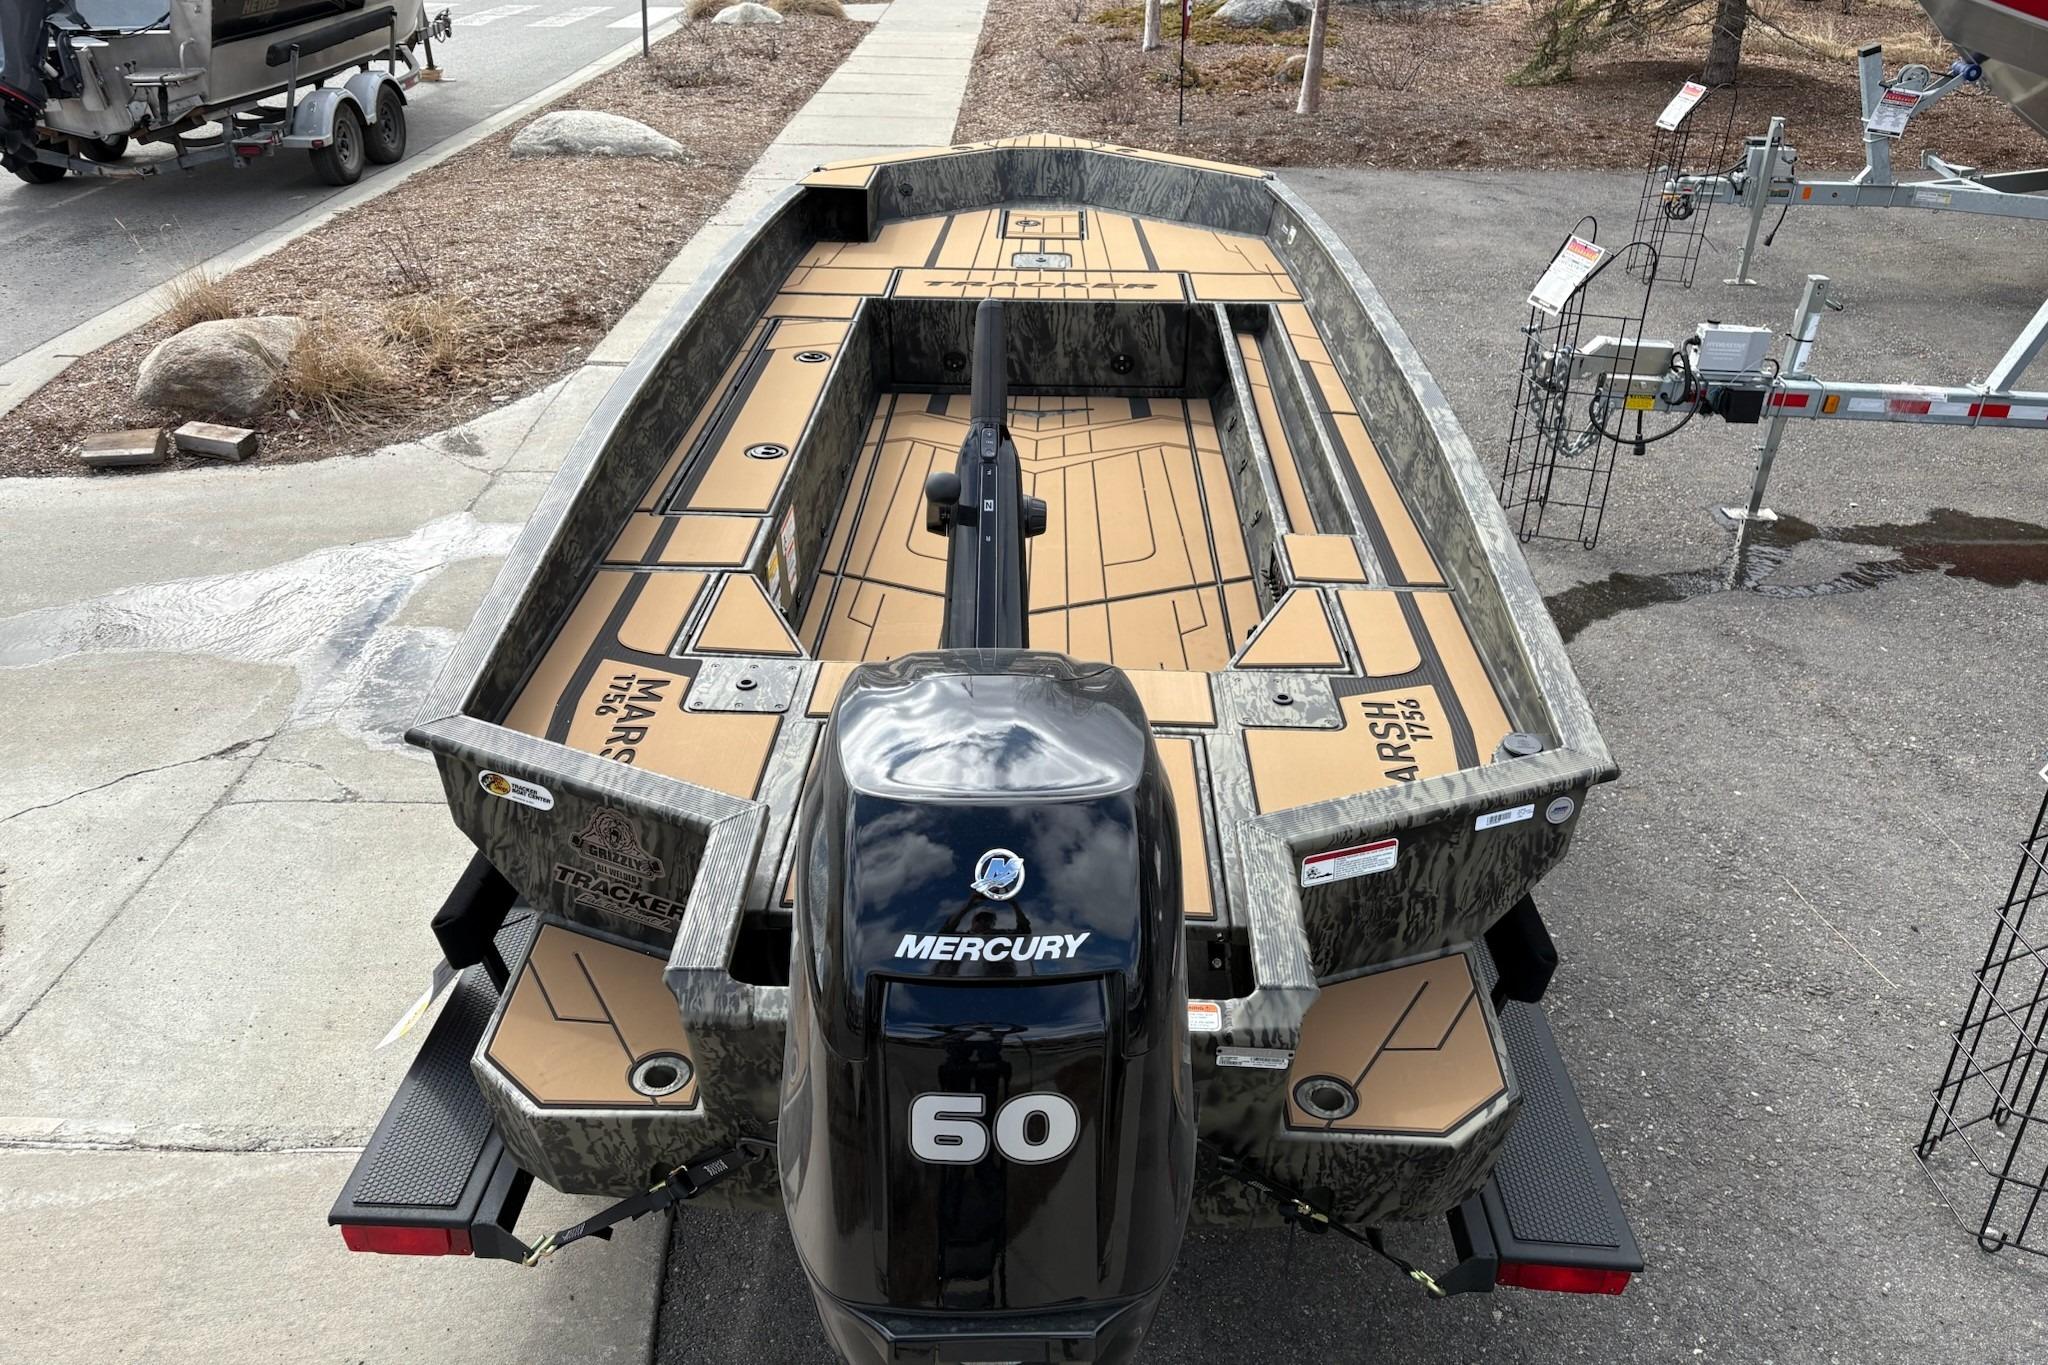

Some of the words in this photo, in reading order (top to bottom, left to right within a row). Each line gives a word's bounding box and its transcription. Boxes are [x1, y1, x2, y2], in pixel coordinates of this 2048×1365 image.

[924, 280, 1158, 290] TRACKER
[595, 674, 636, 716] 1756
[600, 679, 671, 764] MARS
[1397, 699, 1433, 742] 1756
[1361, 702, 1419, 781] ARSH
[512, 784, 538, 795] TRACKER
[512, 788, 527, 797] BOAT
[528, 793, 551, 804] CENTER
[588, 844, 642, 871] GRIZZLY
[596, 863, 609, 875] ALL
[609, 867, 637, 883] WELDED
[554, 865, 686, 918] TRACKER
[894, 932, 1091, 962] MERCURY
[908, 1091, 1081, 1166] 60
